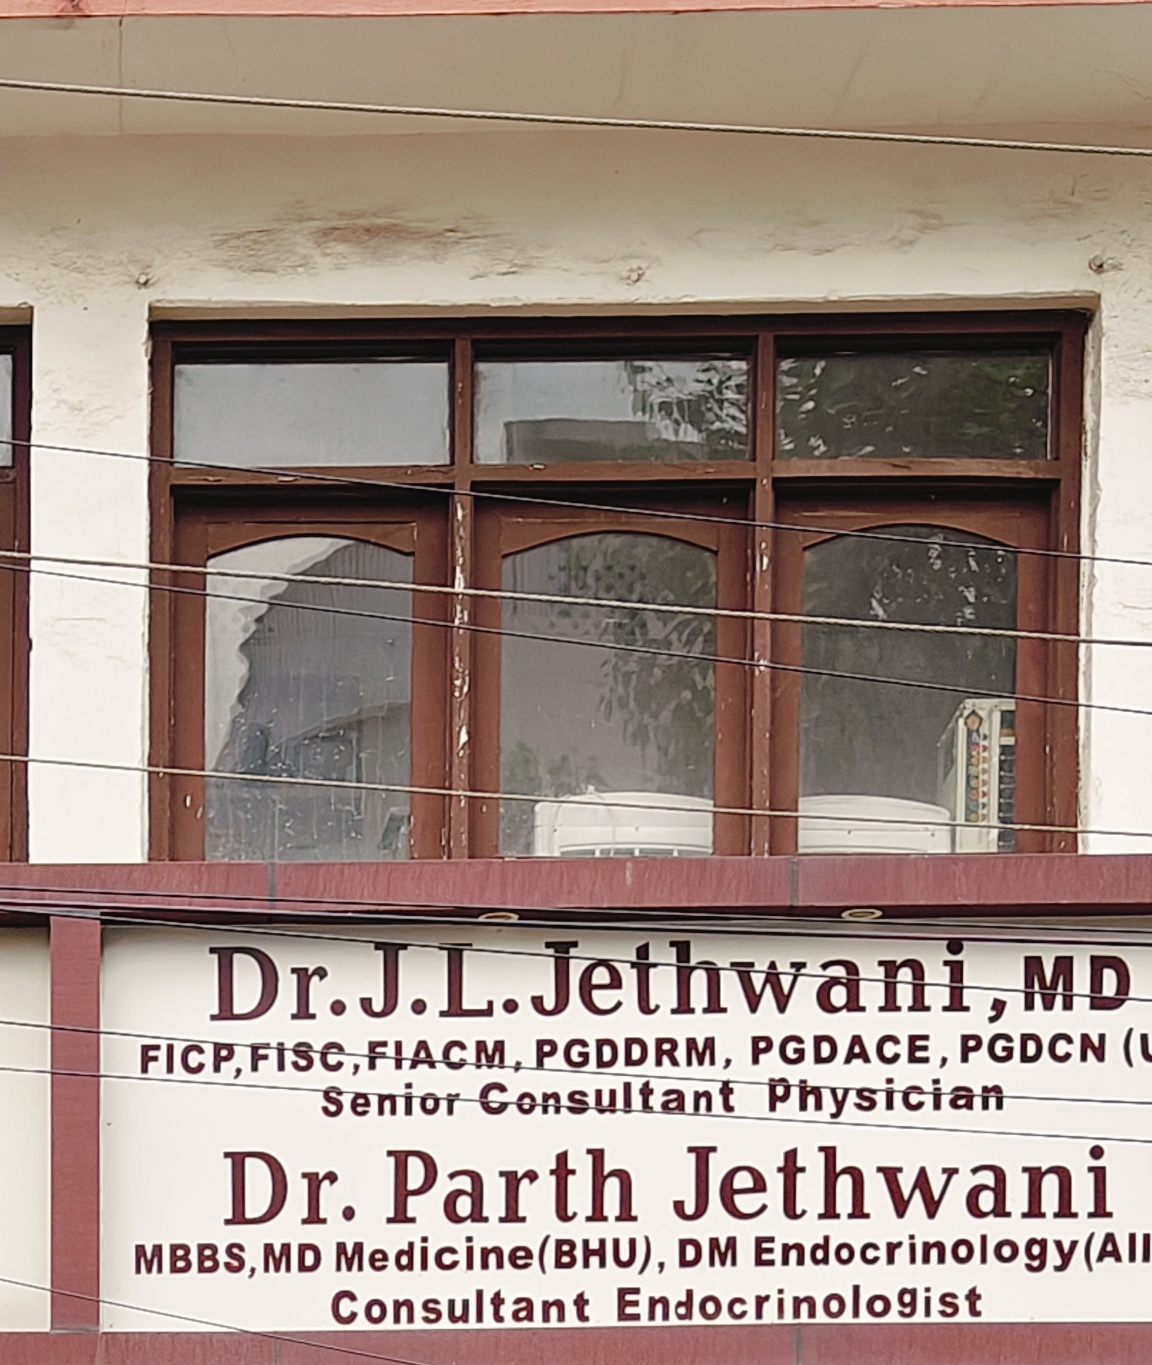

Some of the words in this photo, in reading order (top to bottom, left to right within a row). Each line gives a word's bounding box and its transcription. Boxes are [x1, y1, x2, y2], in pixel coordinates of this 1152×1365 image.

[320, 1082, 461, 1118] Senior
[478, 1080, 736, 1116] Consultant
[767, 1077, 1005, 1119] Physician
[223, 1150, 356, 1226] Dr.
[386, 1147, 639, 1225] Parth
[672, 1144, 1114, 1222] Jethwani
[678, 1237, 737, 1269] DM
[330, 1288, 590, 1326] Consultant
[616, 1285, 983, 1323] Endocrinologist
